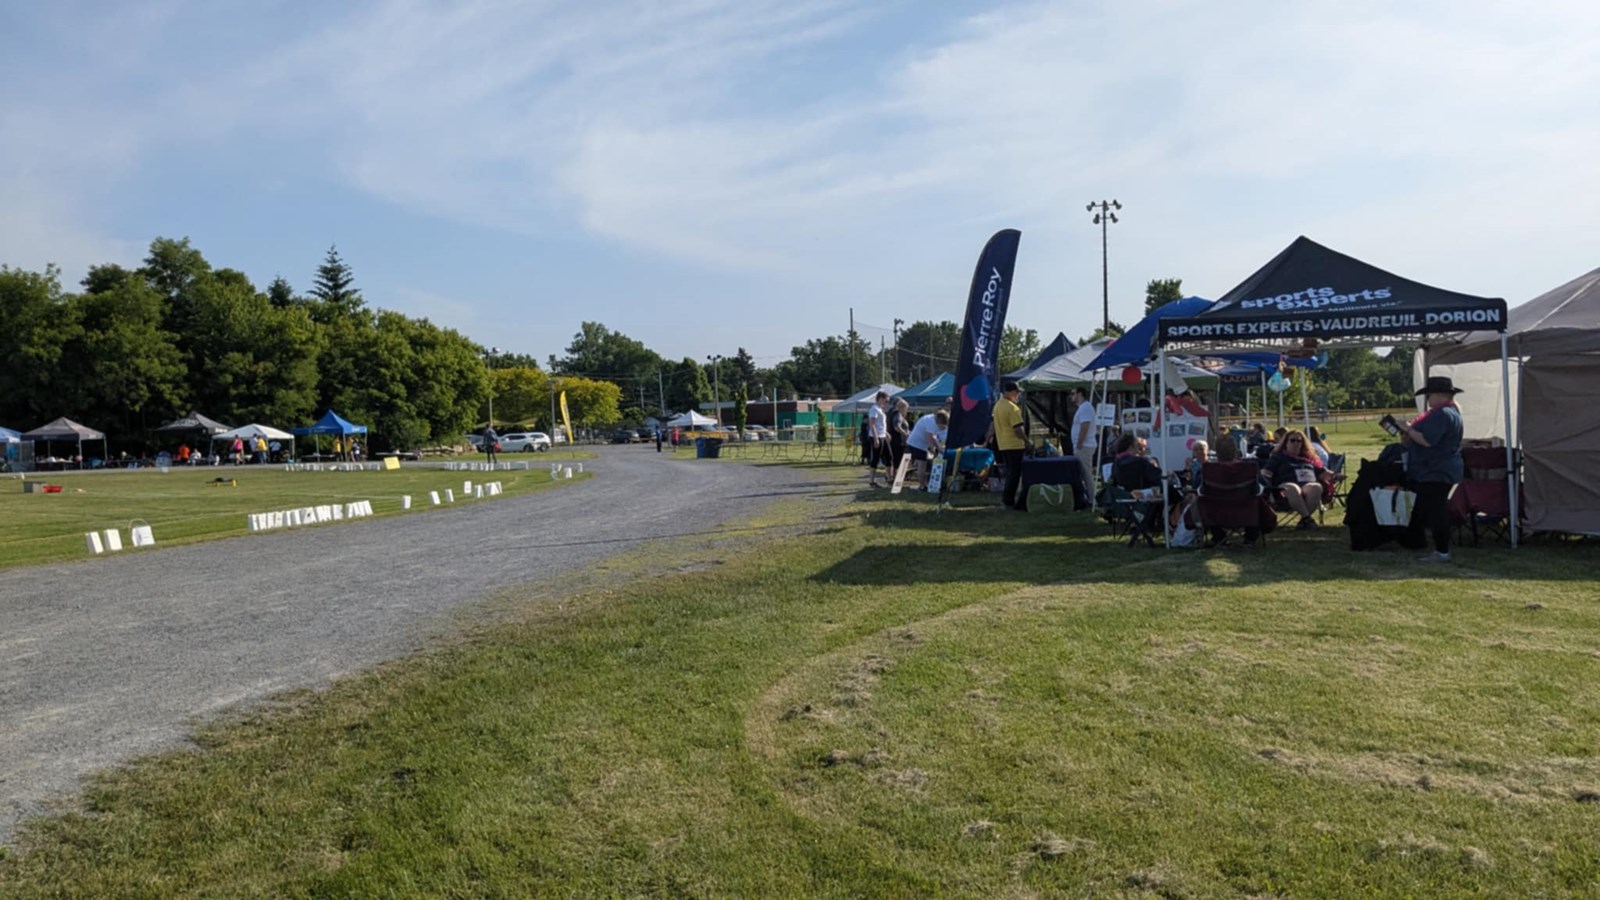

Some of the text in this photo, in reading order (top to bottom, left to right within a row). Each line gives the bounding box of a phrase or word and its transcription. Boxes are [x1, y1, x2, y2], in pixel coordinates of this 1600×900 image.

[982, 266, 1002, 307] Roy
[1241, 287, 1335, 309] sports
[1277, 288, 1392, 310] experts
[972, 308, 994, 367] Pierre
[1167, 323, 1235, 336] SPORTS
